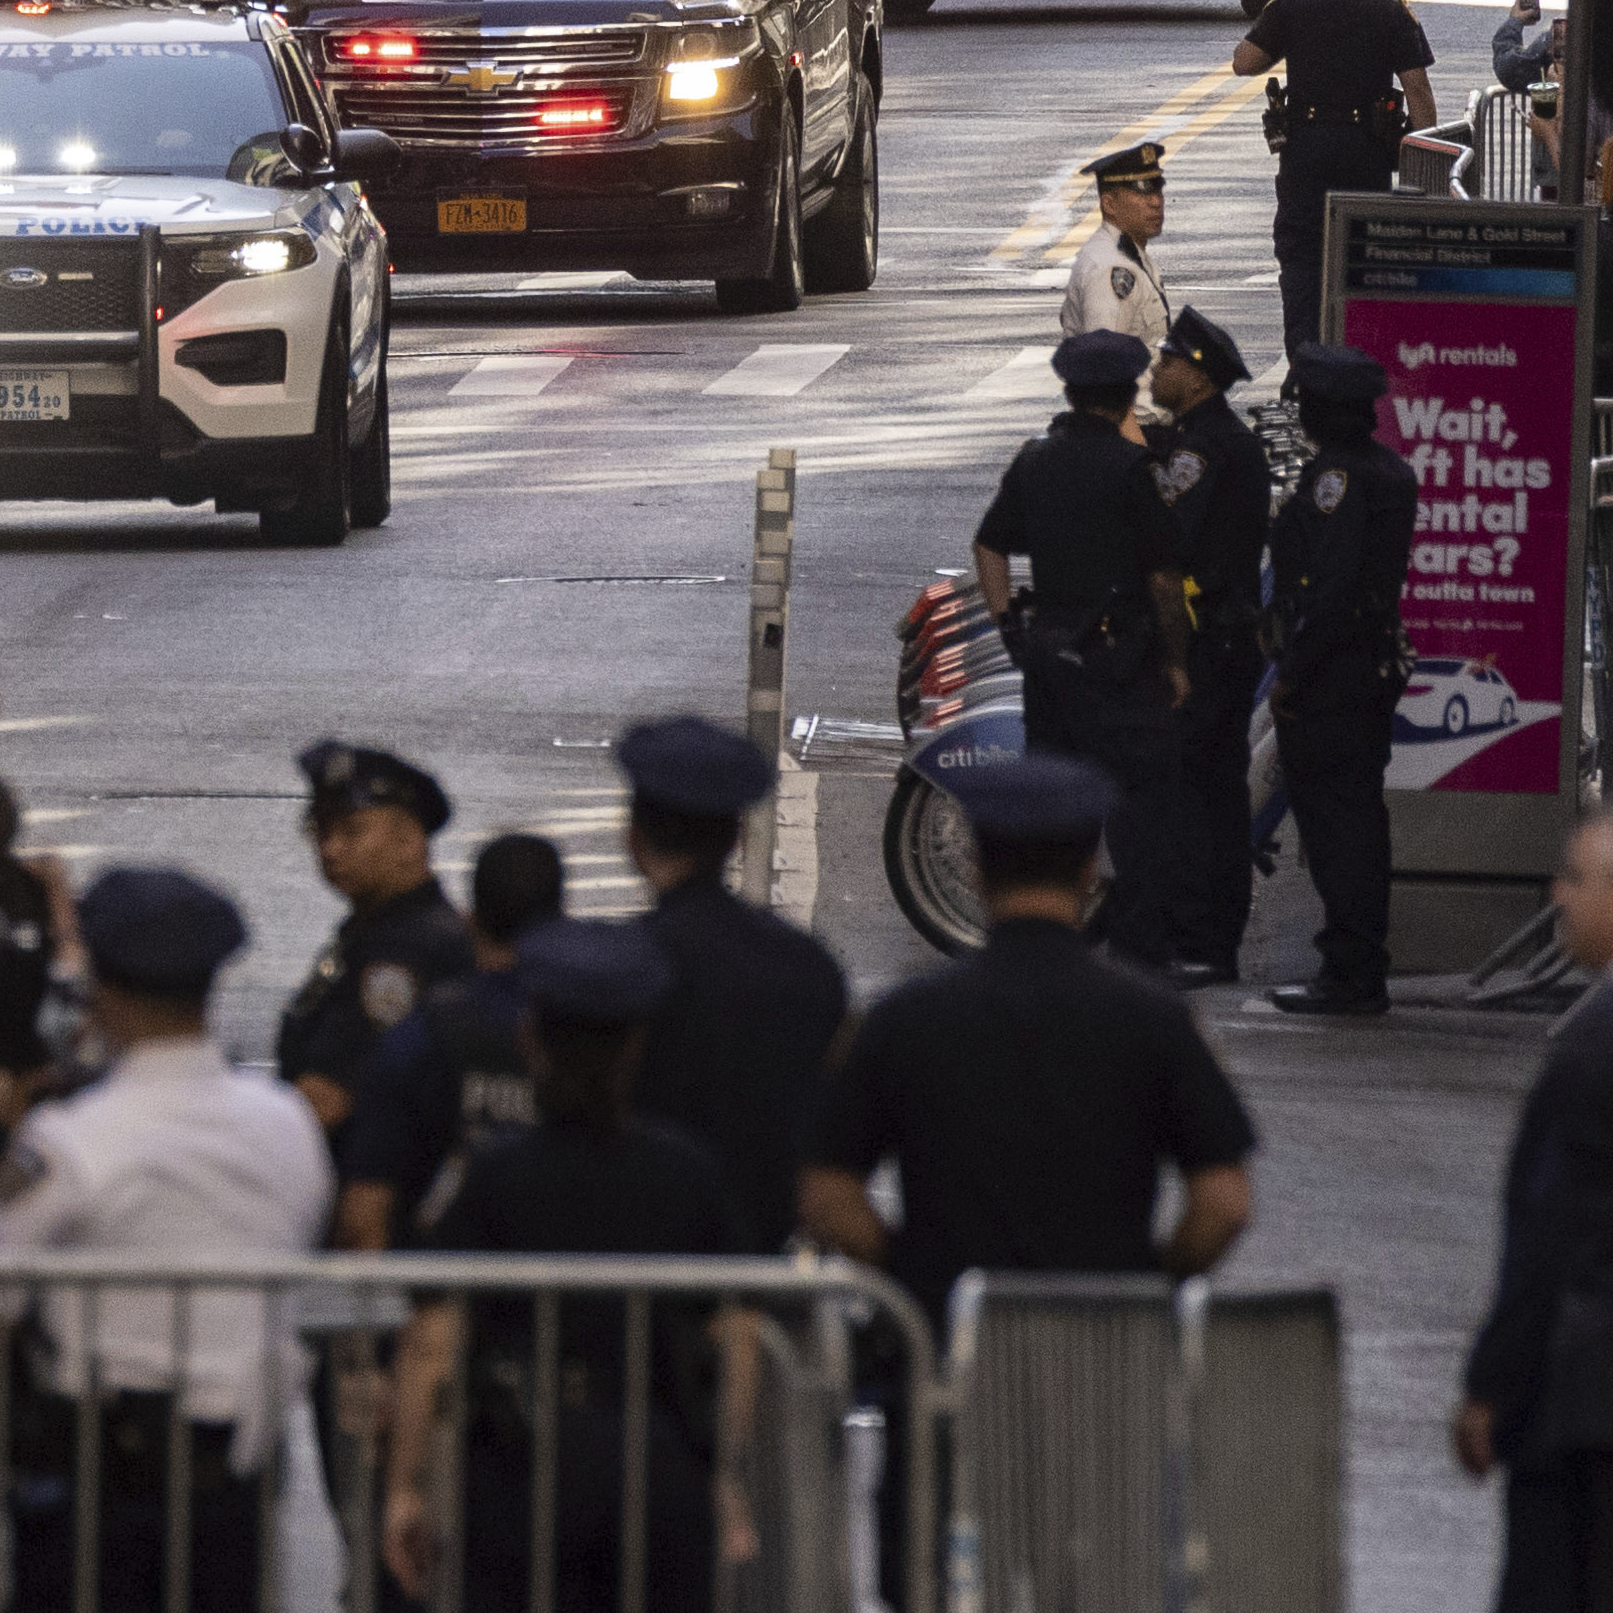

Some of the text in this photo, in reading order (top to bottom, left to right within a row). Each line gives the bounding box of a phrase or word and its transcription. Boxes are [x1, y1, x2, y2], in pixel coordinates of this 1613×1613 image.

[70, 42, 211, 58] PATROL
[1425, 225, 1463, 239] Lane
[1439, 341, 1518, 367] rentals
[0, 410, 42, 420] PATROL
[1392, 396, 1519, 451] Wait,
[1463, 442, 1552, 489] has
[1413, 490, 1529, 534] ental
[1409, 536, 1521, 578] ars?
[1478, 582, 1536, 604] town
